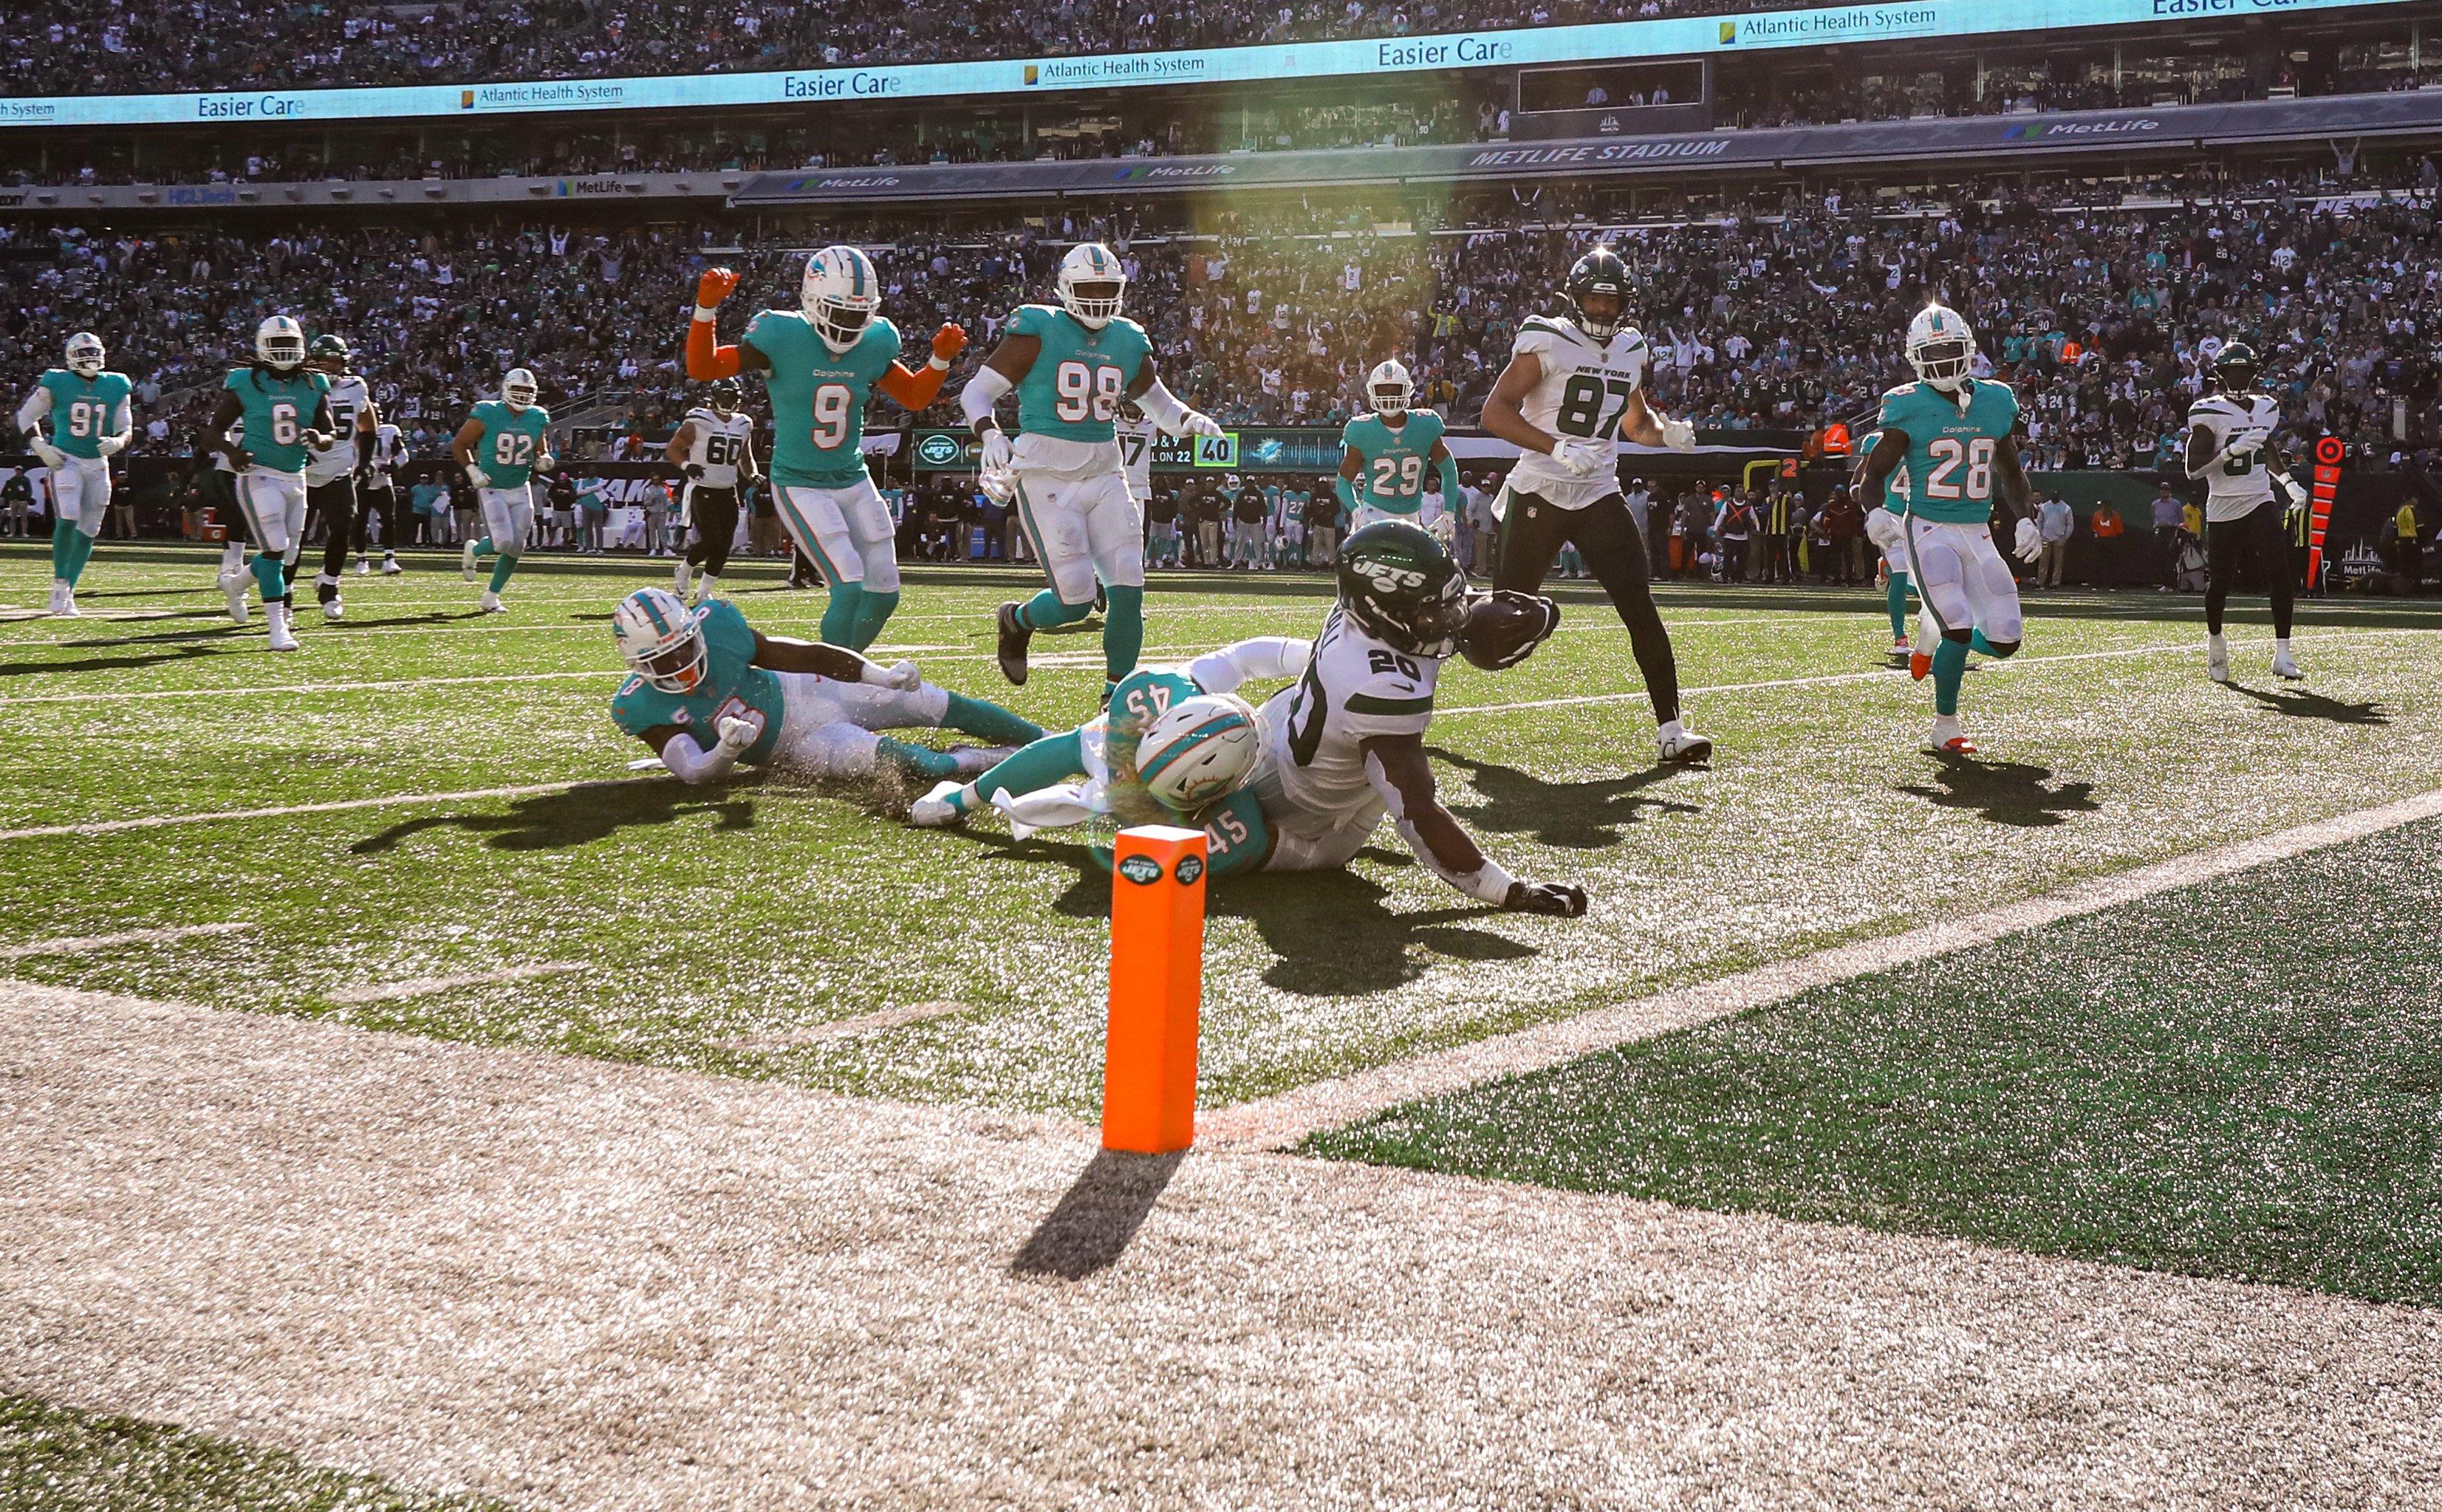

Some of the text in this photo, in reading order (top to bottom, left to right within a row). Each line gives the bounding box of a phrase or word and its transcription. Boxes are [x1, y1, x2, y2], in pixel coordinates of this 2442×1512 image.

[1743, 9, 1936, 35] Atlantic Health System
[1378, 38, 1514, 66] Easier Care
[1044, 55, 1205, 78] Atlantic Health System
[480, 83, 623, 102] Atlantic Health System
[785, 73, 901, 98] Easier Care
[12, 102, 55, 117] System
[199, 95, 304, 117] Easier Care
[2048, 119, 2160, 135] MetLife
[1470, 140, 1731, 166] METLIFE STADIUM
[1148, 164, 1236, 177] MetLife
[576, 181, 621, 194] MetLife
[818, 175, 900, 189] MetLife
[2232, 210, 2242, 220] 15
[2116, 227, 2127, 236] 50
[2217, 248, 2228, 259] 26
[2277, 256, 2289, 267] 12
[1754, 265, 1762, 274] 17
[2175, 273, 2181, 283] 2
[1727, 281, 1738, 290] 73
[1279, 310, 1286, 319] 12
[1837, 309, 1843, 319] 2
[1075, 349, 1110, 360] Dolphins
[1657, 351, 1667, 360] 12
[813, 369, 855, 379] Dolphins
[1575, 366, 1632, 379] NEW YORK
[1055, 360, 1123, 423] 98
[1781, 383, 1787, 392] 6
[1803, 380, 1814, 389] 77
[1744, 389, 1750, 399] 8
[1296, 397, 1302, 406] 2
[1556, 374, 1631, 441] 87
[2049, 395, 2063, 408] 24
[70, 401, 106, 437] 91
[812, 383, 854, 451] 9
[273, 403, 298, 446] 6
[496, 433, 533, 466] 92
[707, 436, 743, 467] 60
[924, 446, 954, 454] JETS
[1119, 436, 1146, 467] 17
[1202, 439, 1228, 462] 40
[1384, 447, 1412, 455] Dolphins
[1160, 452, 1174, 462] ON
[1177, 451, 1191, 463] 22
[2088, 454, 2099, 465] 12
[1782, 458, 1797, 477] 2
[1926, 437, 1997, 501] 28
[1372, 454, 1423, 498] 29
[1288, 502, 1304, 515] 27
[1352, 561, 1426, 588] JETS
[1367, 649, 1422, 683] 20
[1205, 810, 1248, 855] 45
[1122, 864, 1158, 878] JETS
[1177, 864, 1200, 878] JETS
